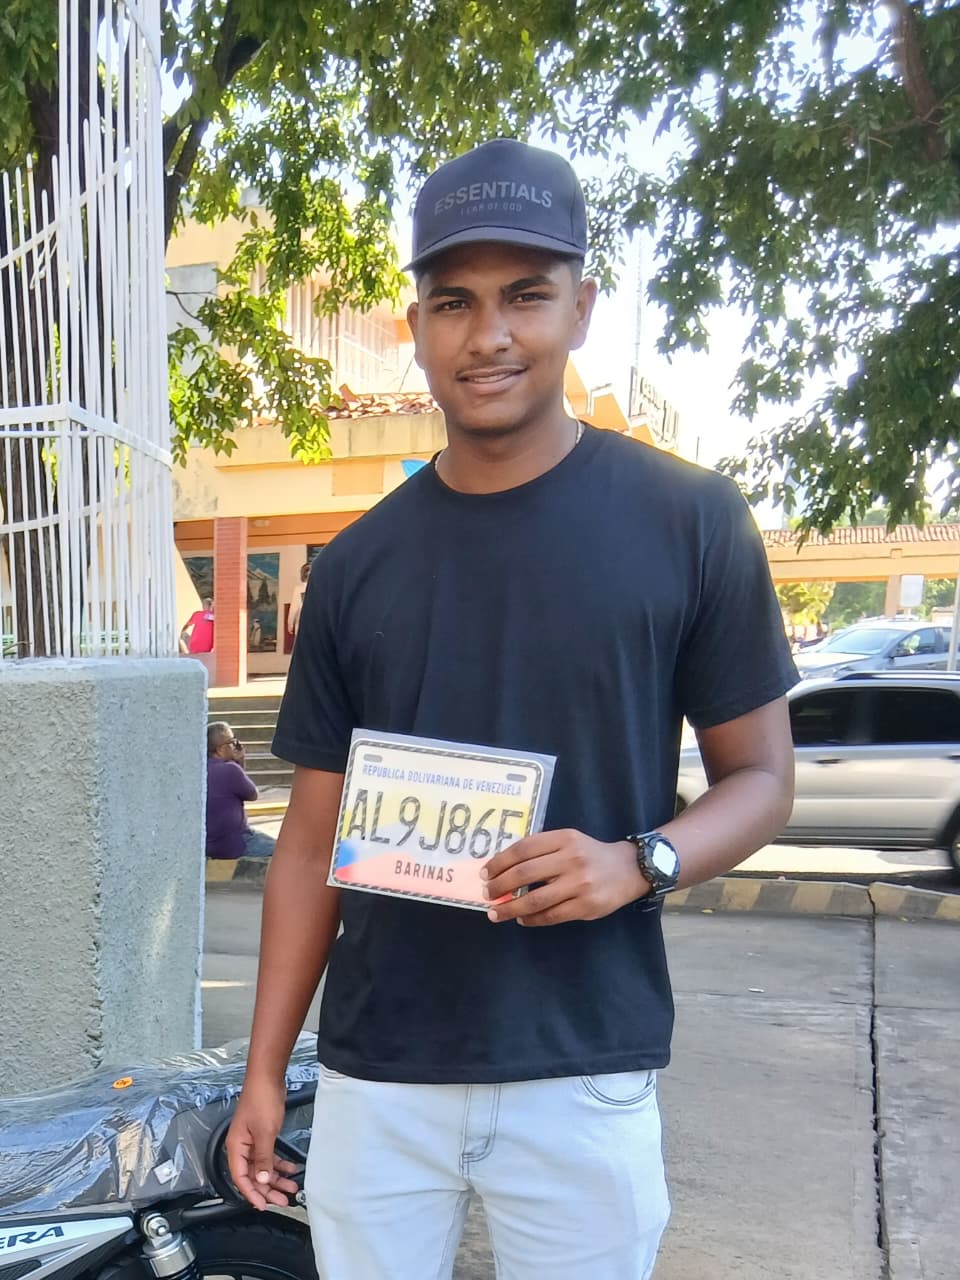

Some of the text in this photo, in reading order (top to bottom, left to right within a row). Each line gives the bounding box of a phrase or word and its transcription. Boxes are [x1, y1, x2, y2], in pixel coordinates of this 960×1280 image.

[434, 181, 553, 216] ESSENTIALS
[407, 770, 461, 790] BOLIVARIANA
[462, 778, 474, 791] DE
[475, 780, 522, 797] VENEZUELA
[394, 859, 455, 883] BARINAS
